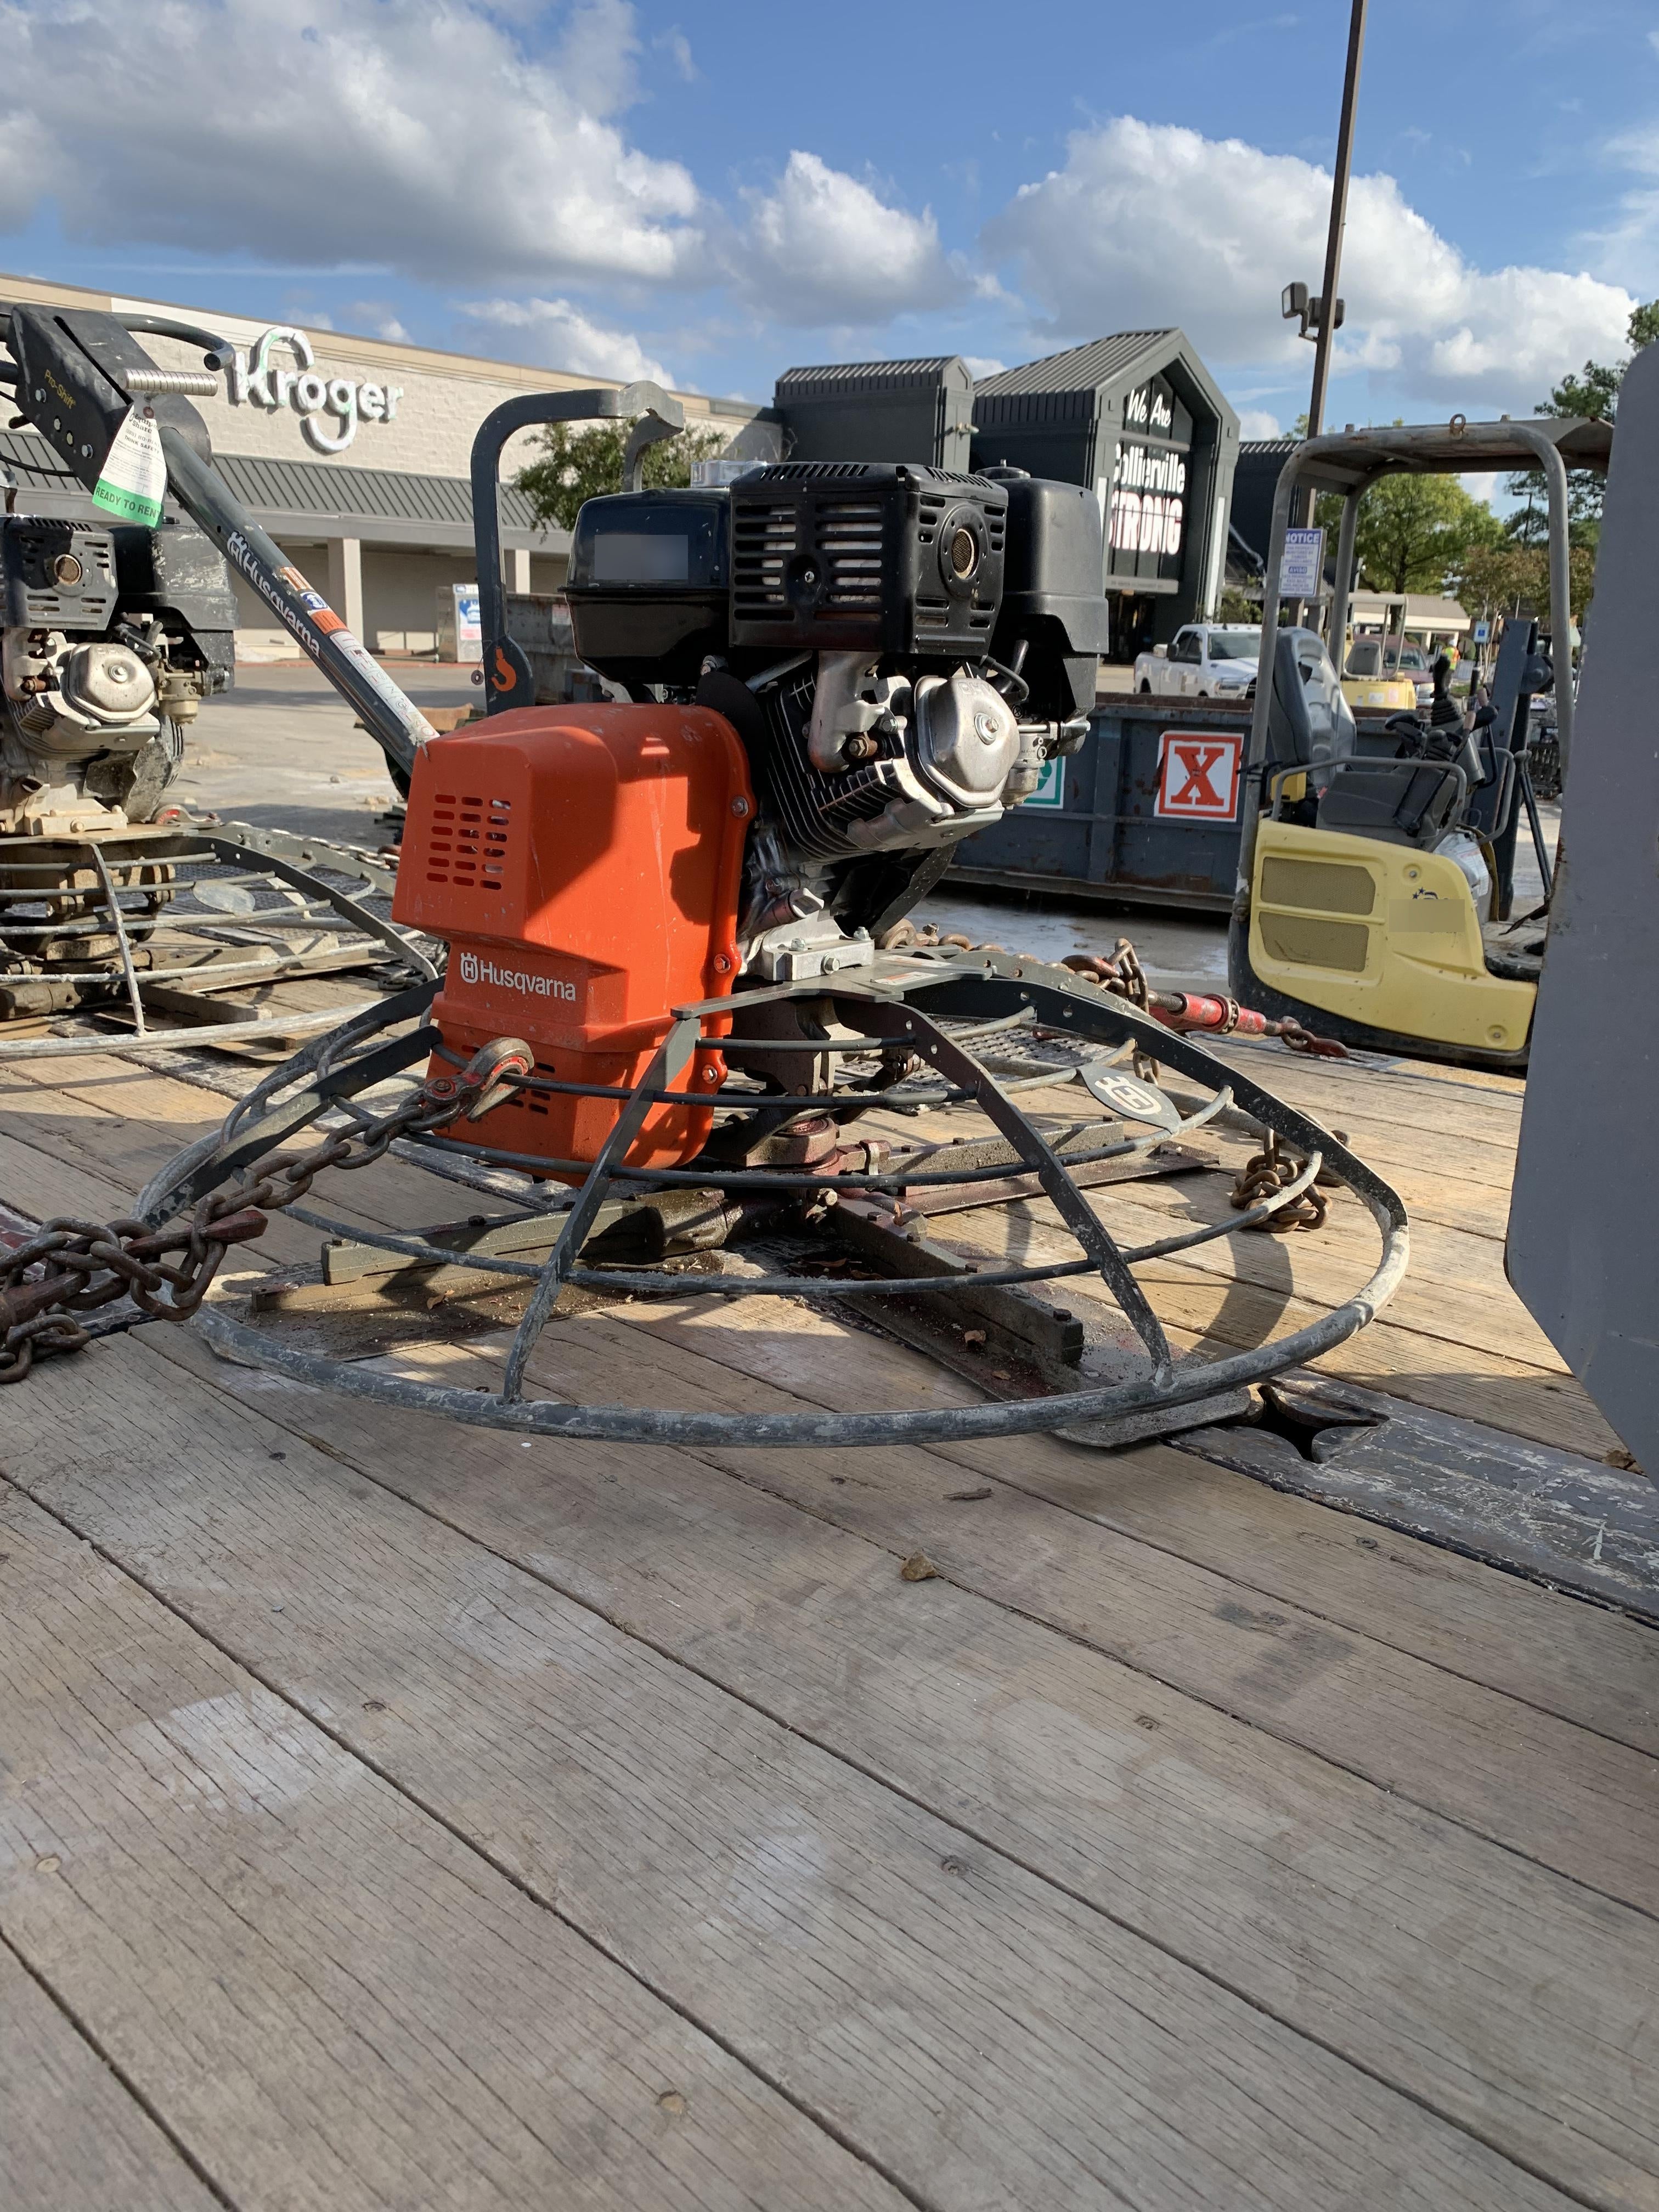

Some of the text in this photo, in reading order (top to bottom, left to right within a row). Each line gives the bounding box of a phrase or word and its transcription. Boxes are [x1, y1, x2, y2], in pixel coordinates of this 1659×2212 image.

[235, 326, 404, 451] Kroger
[1127, 388, 1171, 428] We Are
[125, 435, 160, 455] THINK SAFETY
[95, 486, 122, 505] READY
[124, 499, 136, 511] TO
[1109, 490, 1183, 555] STRONG
[243, 553, 320, 658] Husqvarna
[1171, 746, 1225, 806] X
[480, 960, 576, 1001] Husqvarna
